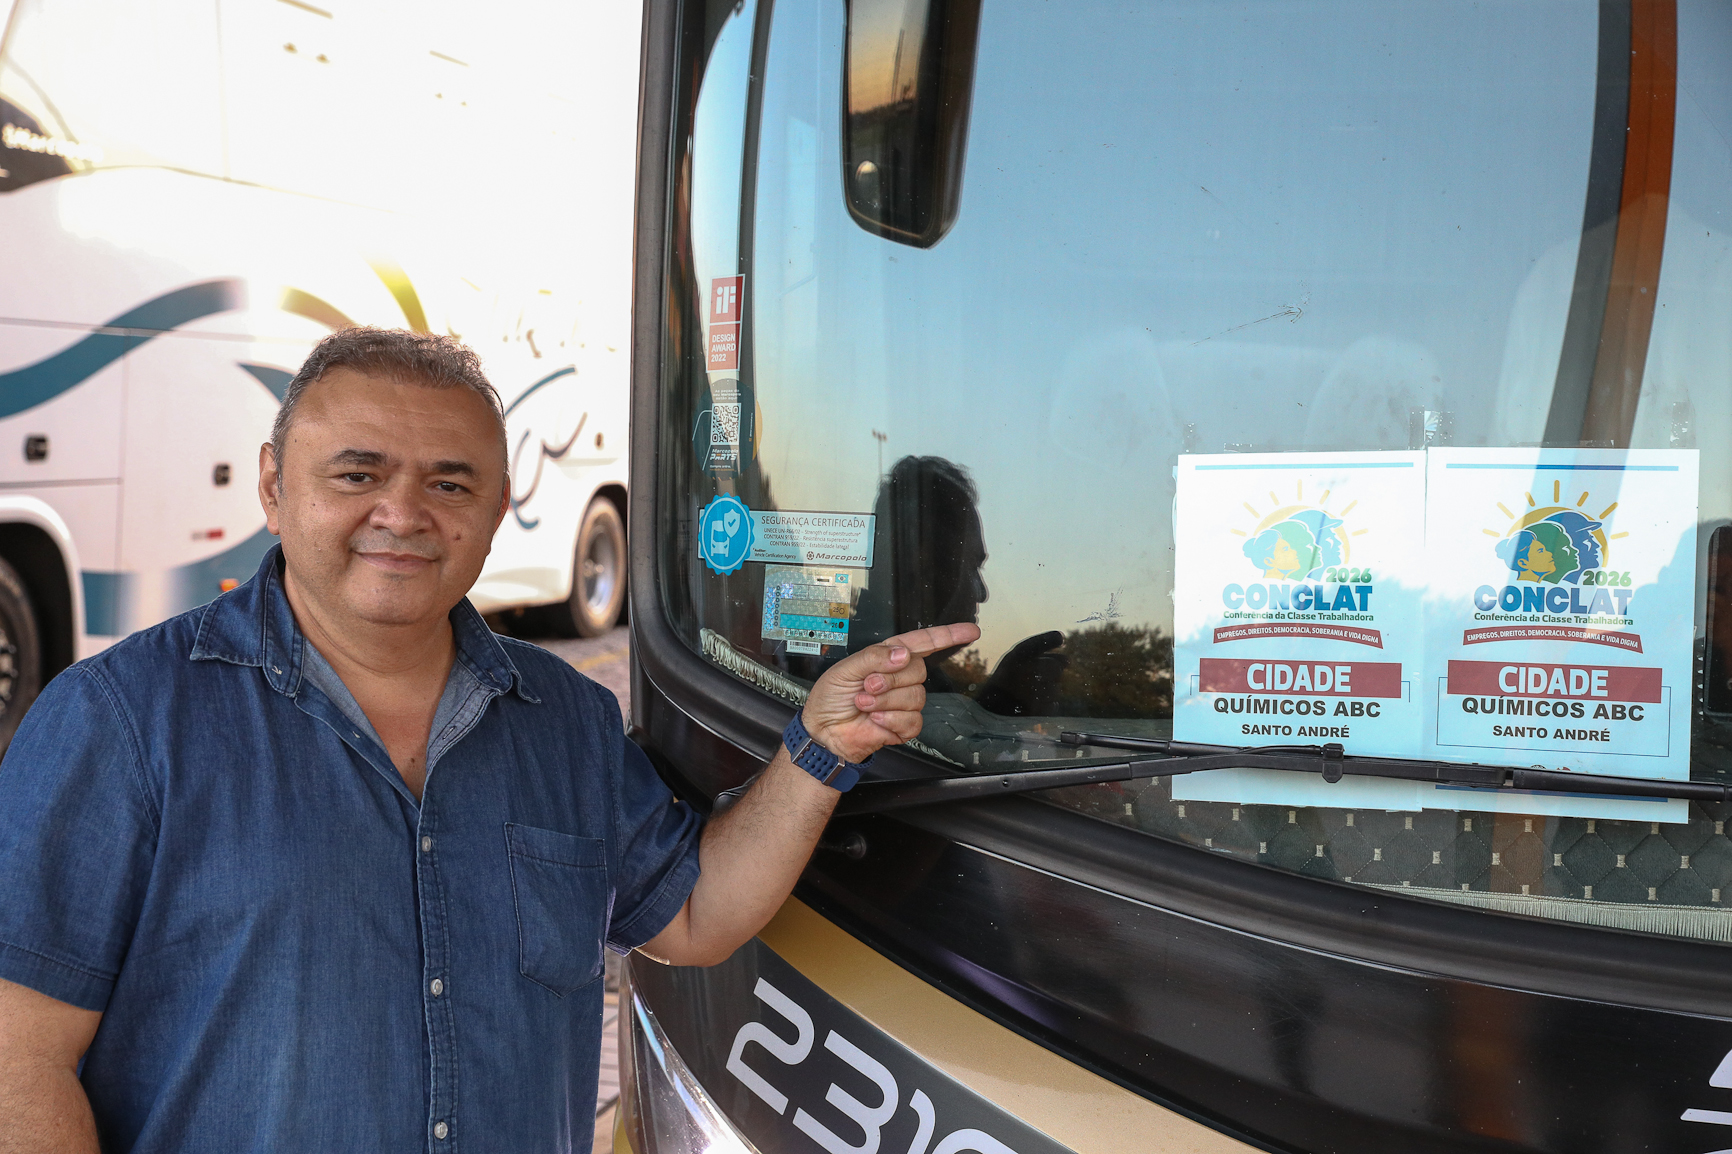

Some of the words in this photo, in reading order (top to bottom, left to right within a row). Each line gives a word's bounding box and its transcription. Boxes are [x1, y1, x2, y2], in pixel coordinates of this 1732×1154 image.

[716, 286, 736, 314] iF
[712, 334, 736, 342] DESIGN
[712, 343, 736, 352] AWARD
[711, 354, 726, 362] 2022
[761, 516, 809, 527] SEGURANÇA
[812, 518, 865, 528] CERTIFICADA
[816, 553, 867, 561] Marcopolo
[1326, 568, 1372, 583] 2026
[1583, 570, 1632, 587] 2026
[1222, 583, 1373, 612] CONCLAT
[1474, 584, 1633, 616] CONCLAT
[1224, 611, 1273, 619] Conferência
[1287, 612, 1316, 620] Classe
[1318, 612, 1374, 621] Trabalhadora
[1474, 613, 1527, 622] Conferência
[1529, 614, 1540, 622] da
[1542, 615, 1572, 623] Classe
[1574, 616, 1633, 625] Trabalhadora
[1217, 629, 1248, 639] EMPREGOS,
[1248, 627, 1273, 635] DIREITOS,
[1312, 627, 1343, 636] SOBERANIA
[1362, 634, 1379, 643] DIGNA
[1467, 631, 1500, 641] EMPREGOS,
[1528, 629, 1567, 637] DEMOCRACIA,
[1568, 630, 1600, 640] SOBERANIA
[1606, 635, 1620, 644] VIDA
[1620, 638, 1638, 648] DIGNA
[1246, 663, 1351, 692] CIDADE
[1498, 666, 1609, 697] CIDADE
[1214, 695, 1326, 717] QUÍMICOS
[1333, 701, 1381, 718] ABC
[1462, 695, 1585, 719] QUÍMICOS
[1593, 703, 1645, 722] ABC
[1241, 724, 1292, 736] SANTO
[1297, 724, 1350, 738] ANDRÉ
[1493, 725, 1548, 739] SANTO
[1553, 728, 1610, 742] ANDRÉ
[726, 977, 1018, 1154] 231
